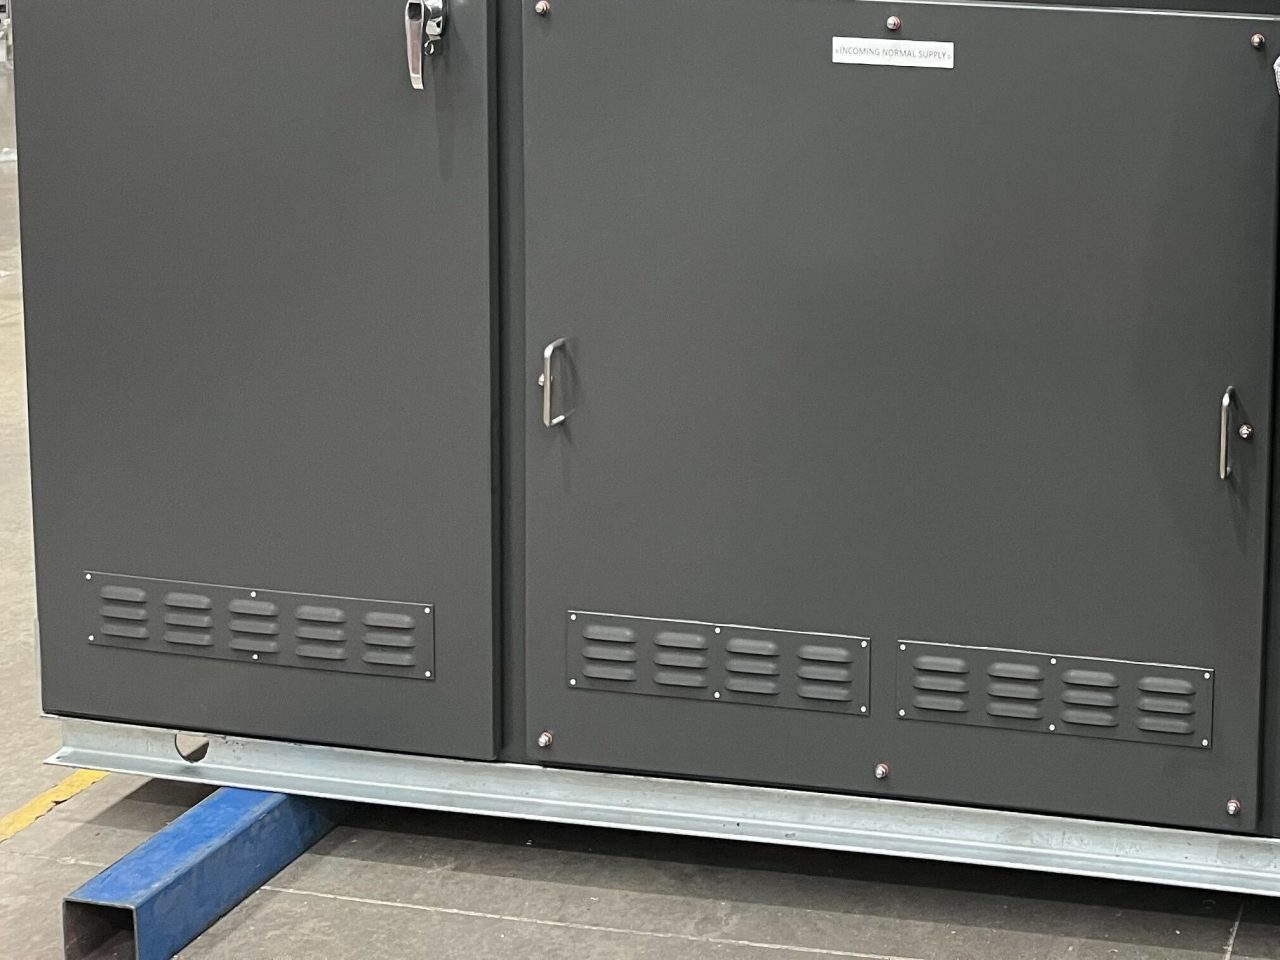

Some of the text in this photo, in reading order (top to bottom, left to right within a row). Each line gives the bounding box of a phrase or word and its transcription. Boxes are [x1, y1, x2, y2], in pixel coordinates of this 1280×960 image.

[839, 46, 946, 59] INCOMING NORMAL SUPPLY
